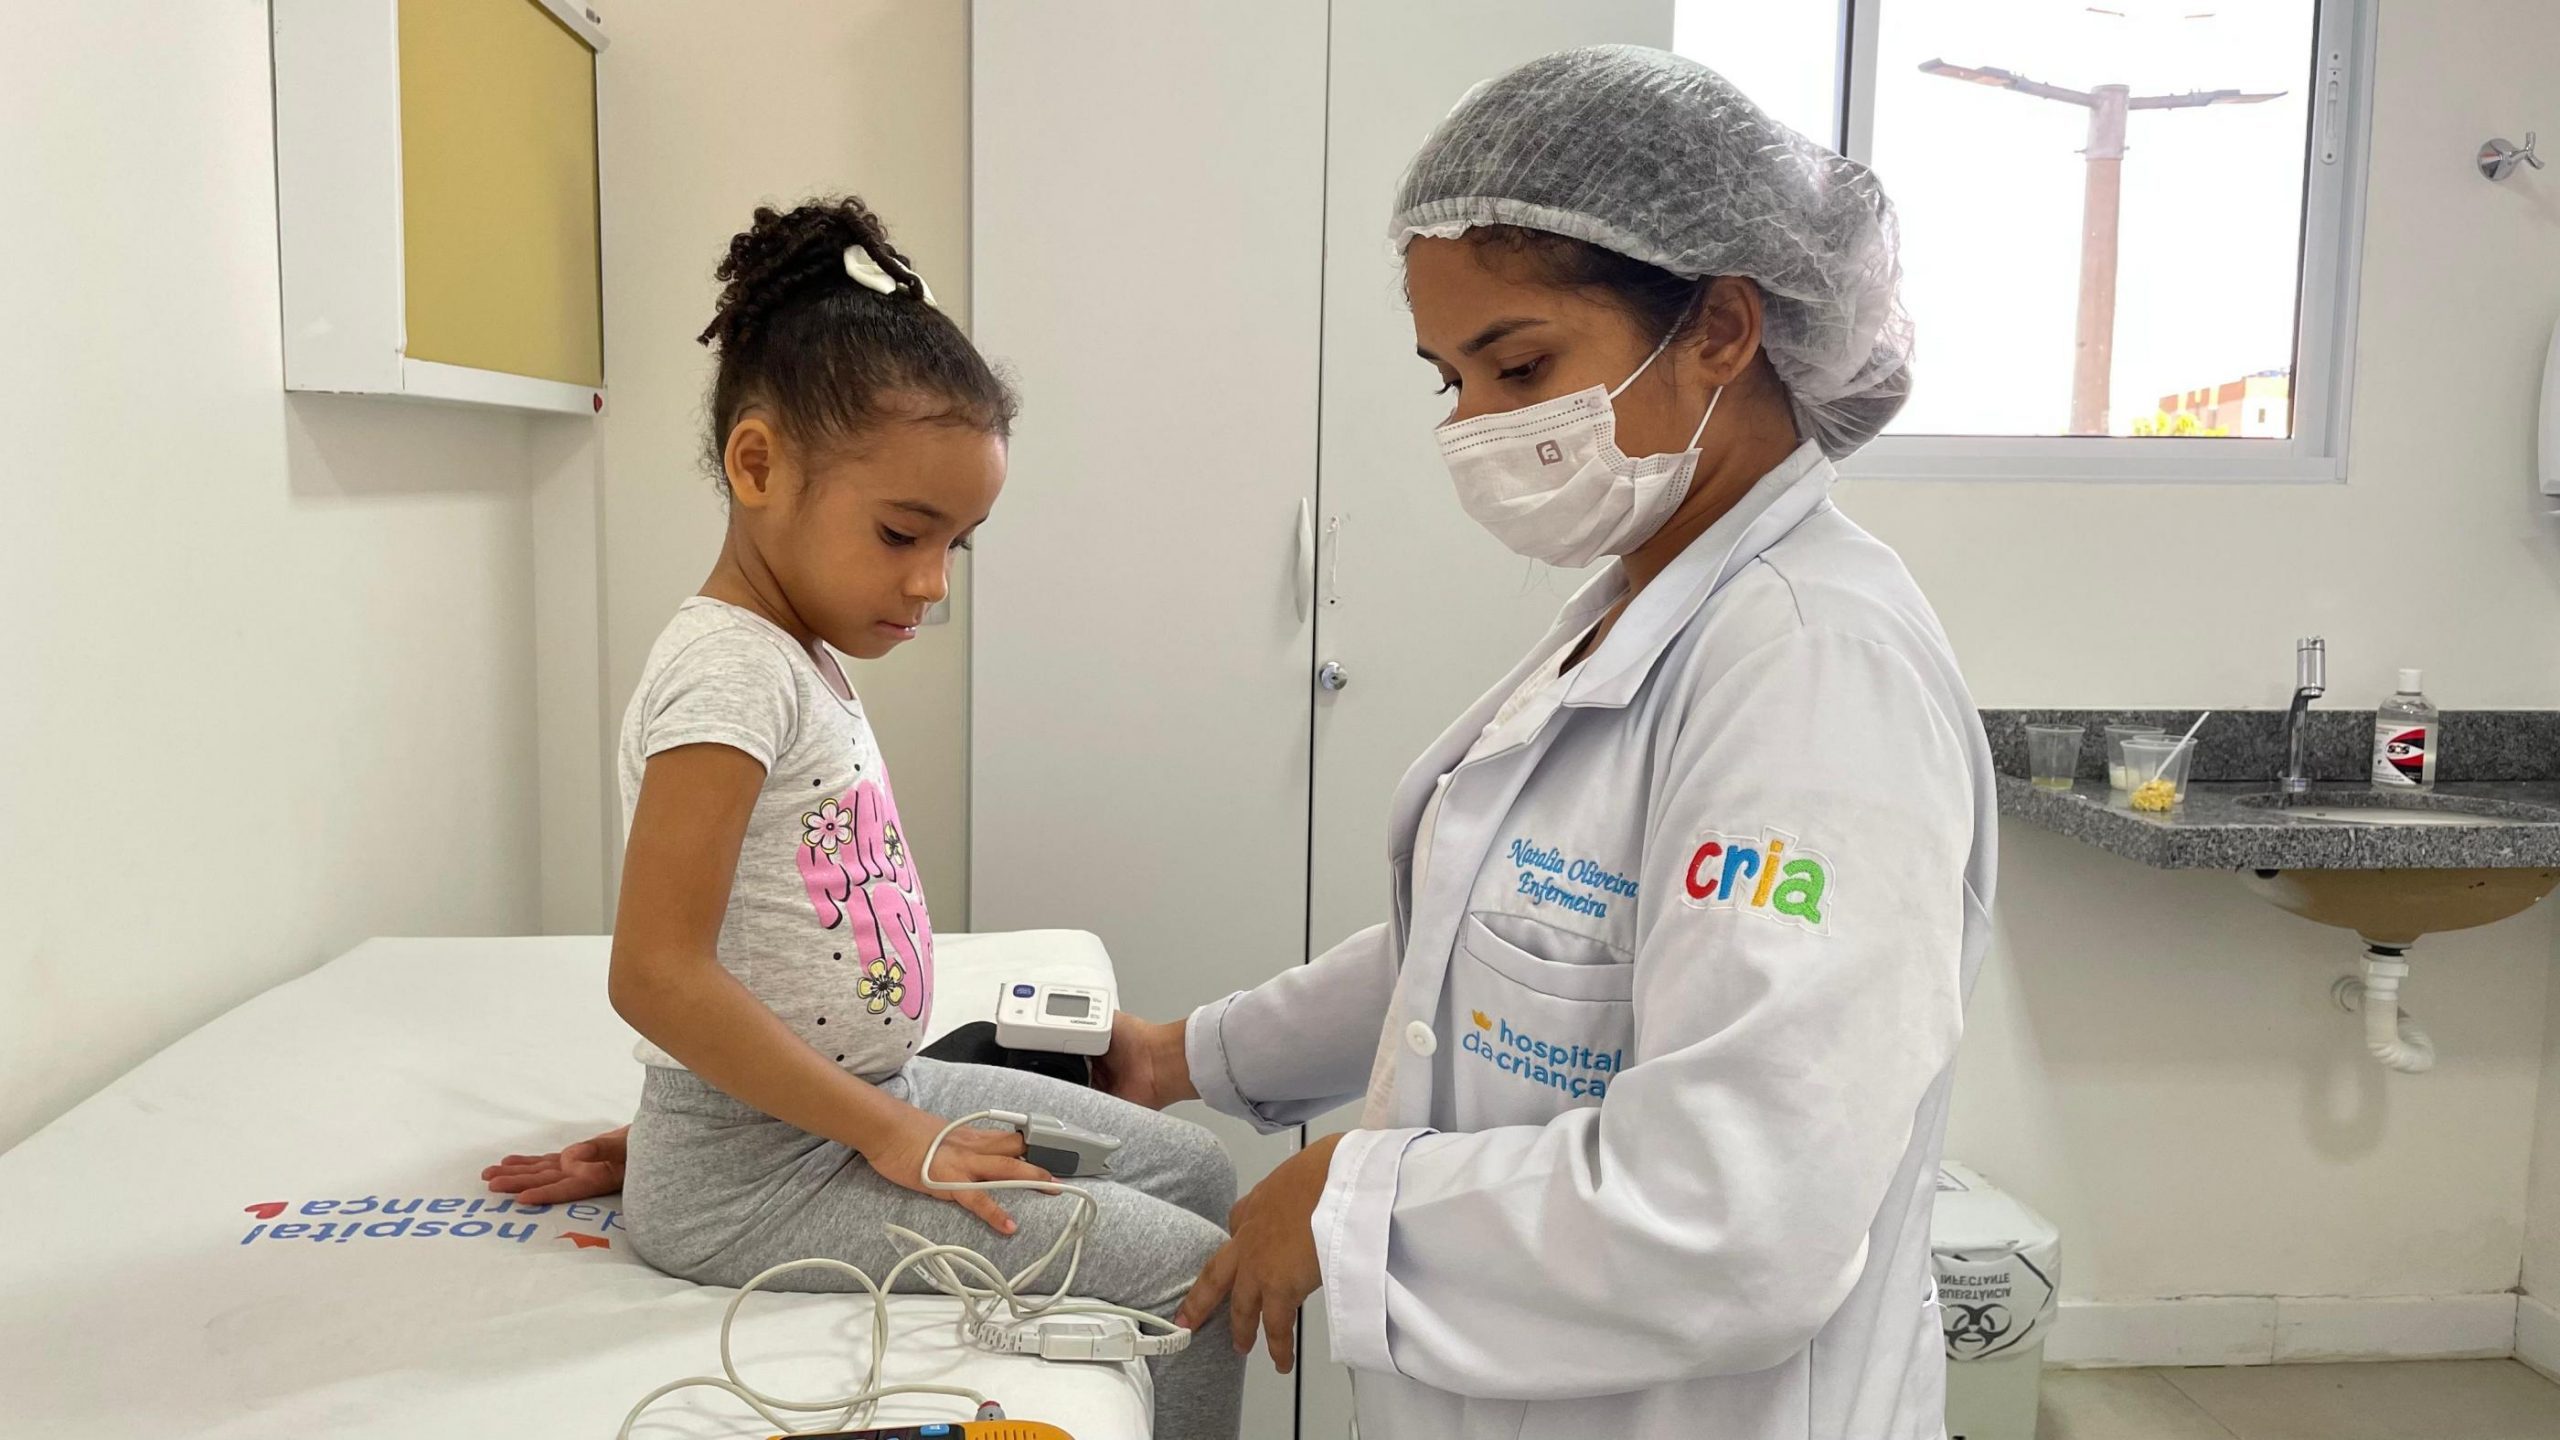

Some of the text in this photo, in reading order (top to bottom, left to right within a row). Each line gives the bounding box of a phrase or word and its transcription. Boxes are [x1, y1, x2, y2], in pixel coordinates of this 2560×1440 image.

[1518, 871, 1607, 918] Enfermeira
[1568, 859, 1639, 898] Oliveira
[1686, 839, 1825, 924] cria
[1462, 1023, 1606, 1099] da criança
[1500, 1018, 1623, 1074] hospital
[299, 1196, 554, 1218] criança
[241, 1217, 539, 1246] hospital
